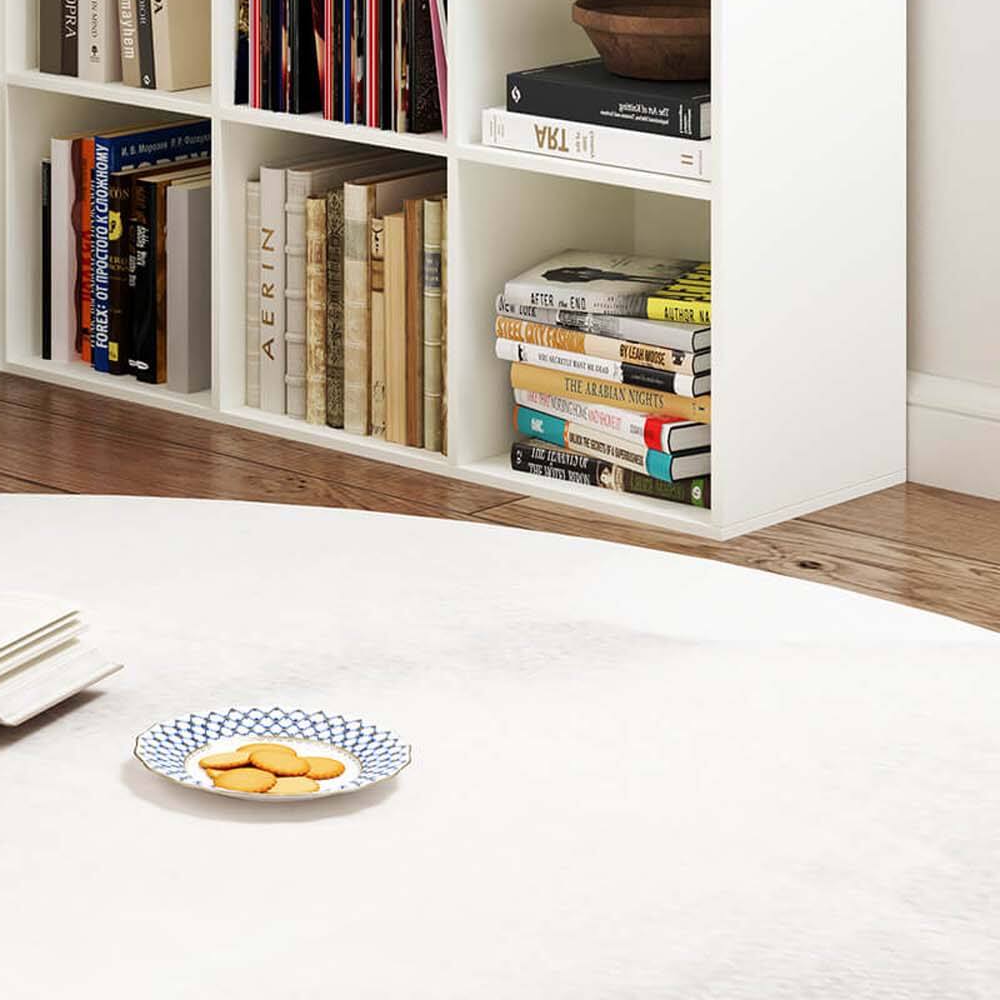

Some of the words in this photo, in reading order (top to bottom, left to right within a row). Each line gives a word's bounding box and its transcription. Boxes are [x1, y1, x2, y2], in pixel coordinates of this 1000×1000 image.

[95, 144, 109, 213] СЛОЖНОМУ
[96, 215, 109, 224] К
[96, 225, 109, 283] ПРОСТОГО
[96, 285, 108, 301] ОТ
[261, 227, 276, 360] AERIN
[531, 293, 553, 308] AFTER
[570, 296, 587, 311] END
[95, 304, 109, 348] FOREX:
[664, 306, 694, 322] AUTHOR
[620, 344, 629, 357] BY
[564, 377, 584, 394] THE
[585, 381, 627, 401] ARABIAN
[628, 388, 665, 408] NIGHTS
